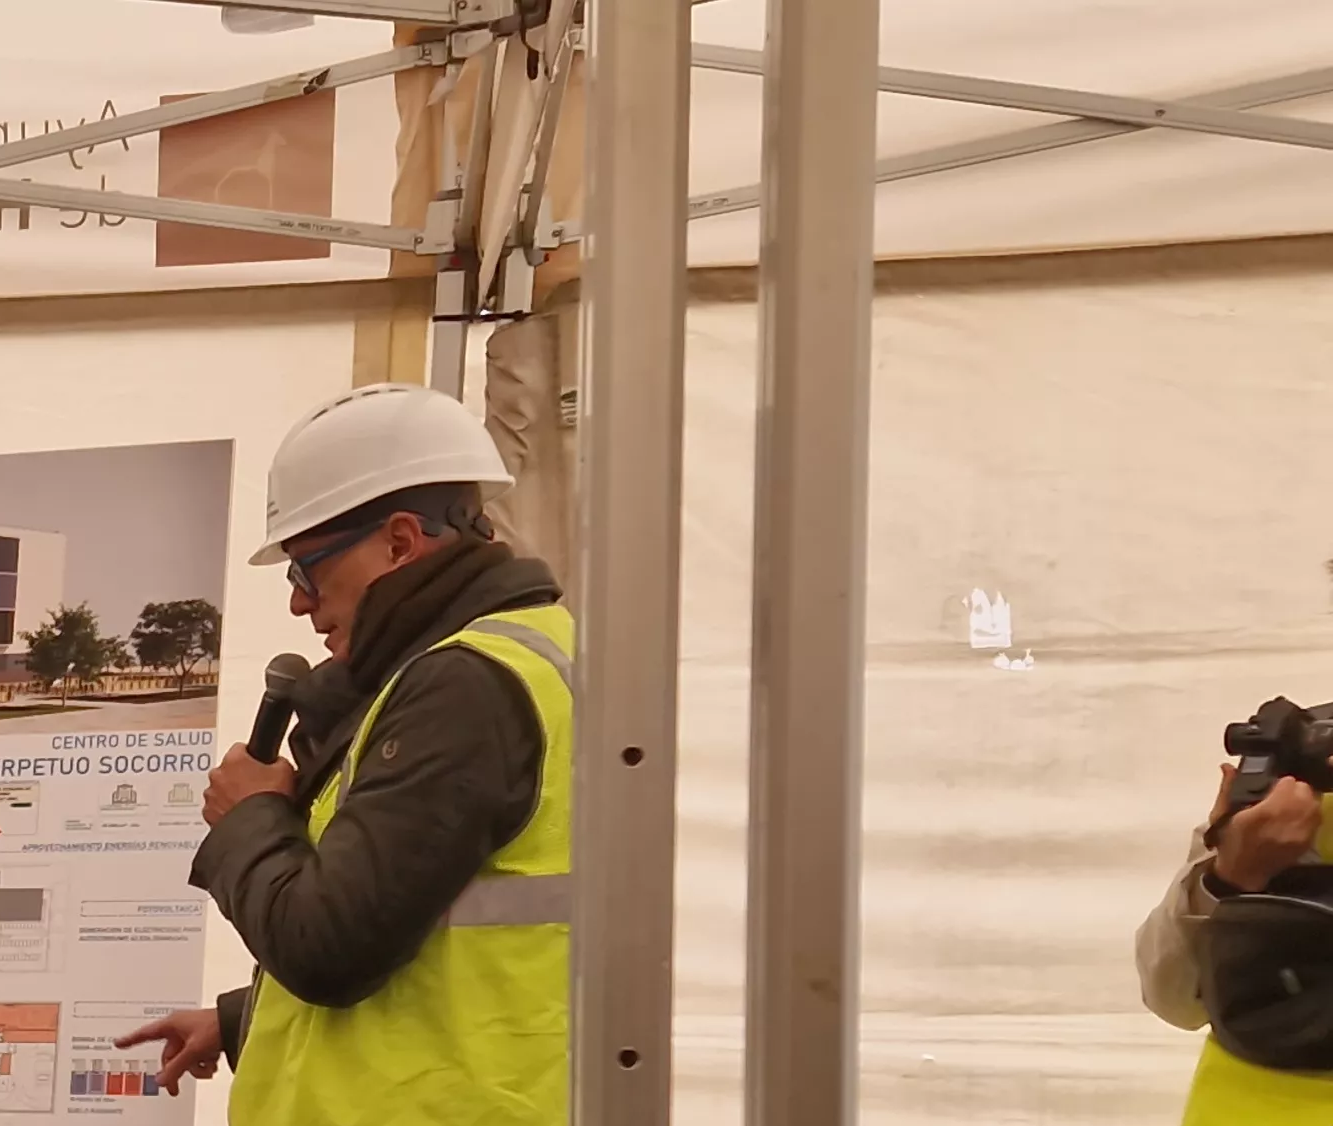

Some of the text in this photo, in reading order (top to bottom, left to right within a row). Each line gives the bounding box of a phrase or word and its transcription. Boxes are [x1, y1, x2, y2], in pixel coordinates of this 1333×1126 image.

[52, 731, 213, 750] CENTRO DE SALUD
[98, 753, 211, 774] SOCORRO
[148, 840, 199, 851] RENOVABLE
